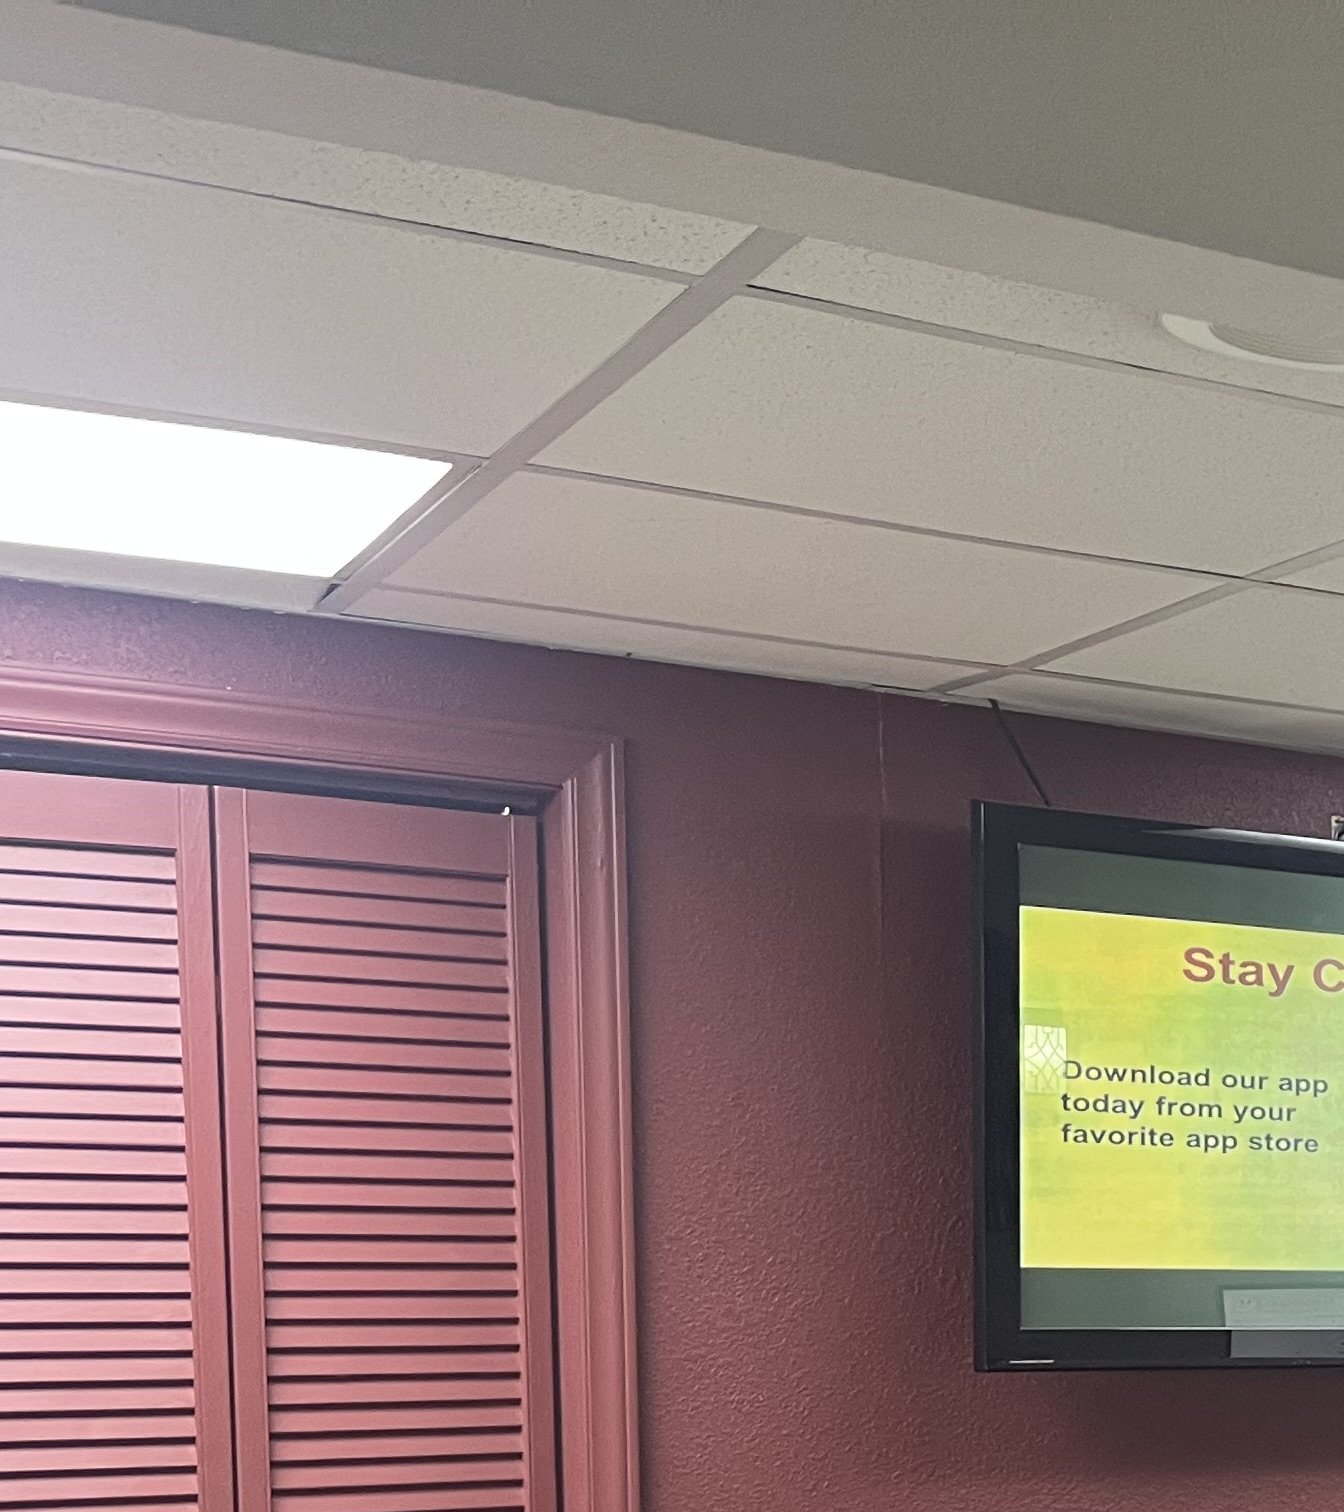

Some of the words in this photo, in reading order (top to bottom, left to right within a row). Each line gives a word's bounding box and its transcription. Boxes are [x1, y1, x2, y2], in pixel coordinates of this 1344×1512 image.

[1182, 947, 1295, 997] Stay
[1063, 1060, 1210, 1087] Download
[1221, 1073, 1268, 1090] our
[1278, 1077, 1329, 1098] app
[1060, 1093, 1145, 1119] today
[1156, 1096, 1222, 1118] from
[1233, 1104, 1296, 1124] your
[1060, 1123, 1174, 1147] favorite
[1186, 1132, 1238, 1154] app
[1248, 1133, 1319, 1153] store
